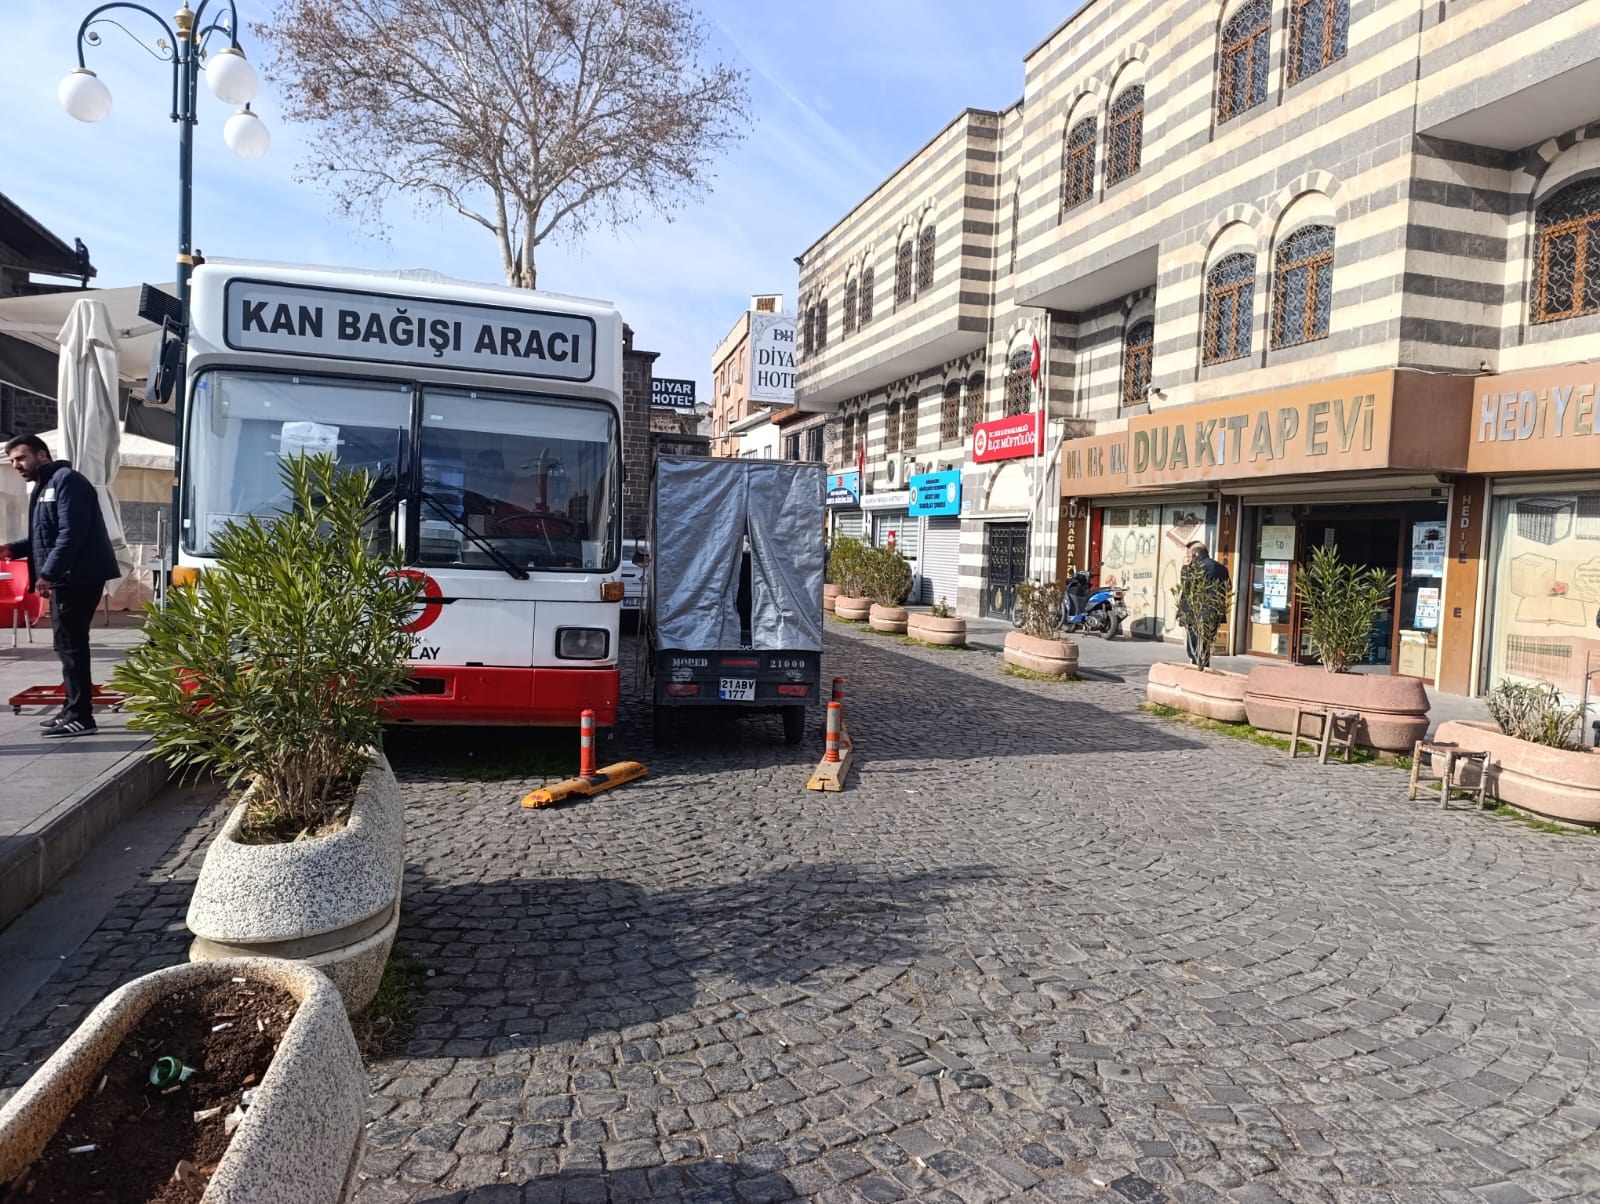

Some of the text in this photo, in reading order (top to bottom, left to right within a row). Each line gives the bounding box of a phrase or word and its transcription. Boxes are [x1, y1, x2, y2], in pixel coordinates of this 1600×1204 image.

[242, 299, 580, 363] KAN BAĞIŞI ARACI
[652, 380, 691, 394] DİYAR
[652, 393, 691, 406] HOTEL
[1134, 394, 1375, 473] DUA KİTAP EVİ
[1061, 505, 1086, 519] DUA
[721, 679, 754, 689] 21 ABV
[728, 690, 745, 699] 177
